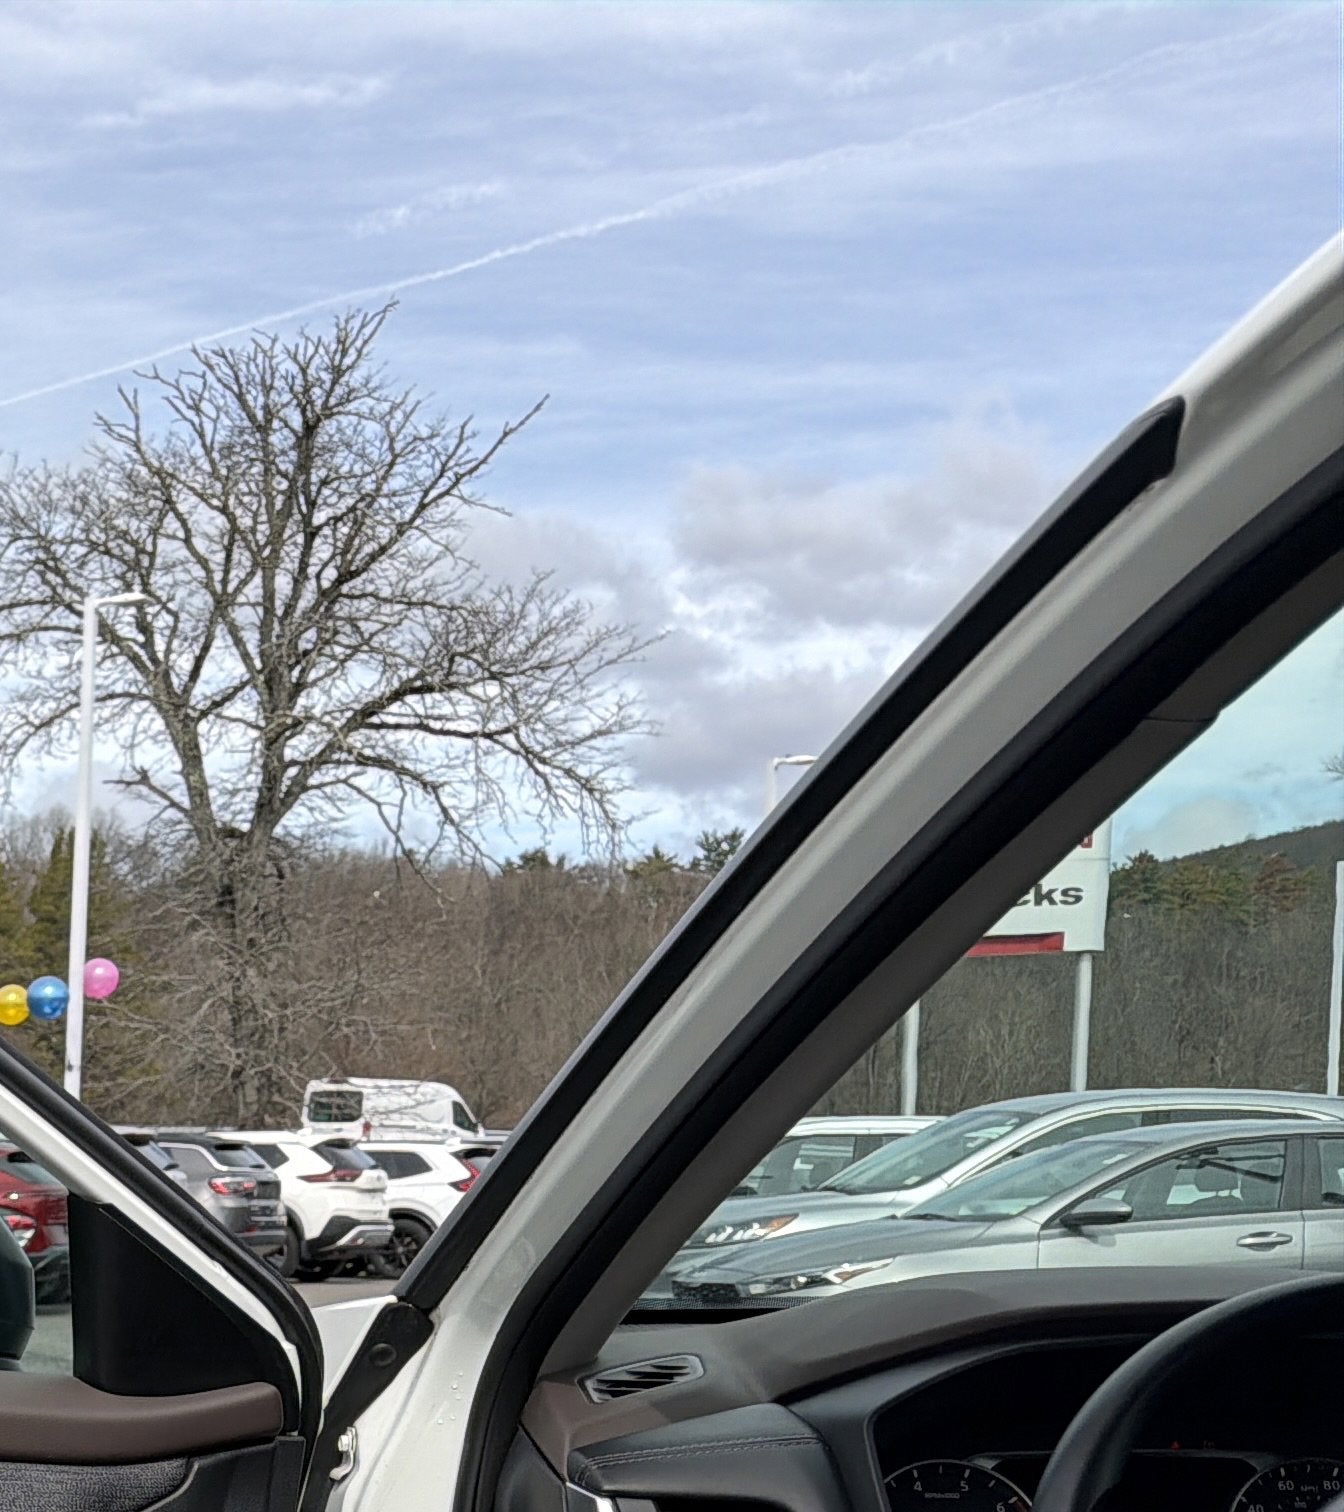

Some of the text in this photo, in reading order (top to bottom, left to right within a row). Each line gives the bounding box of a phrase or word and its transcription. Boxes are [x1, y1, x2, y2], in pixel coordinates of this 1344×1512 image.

[913, 1481, 922, 1491] 4
[960, 1481, 969, 1491] 5
[1277, 1480, 1295, 1491] 60
[1323, 1480, 1341, 1491] 80
[996, 1501, 1006, 1512] 6
